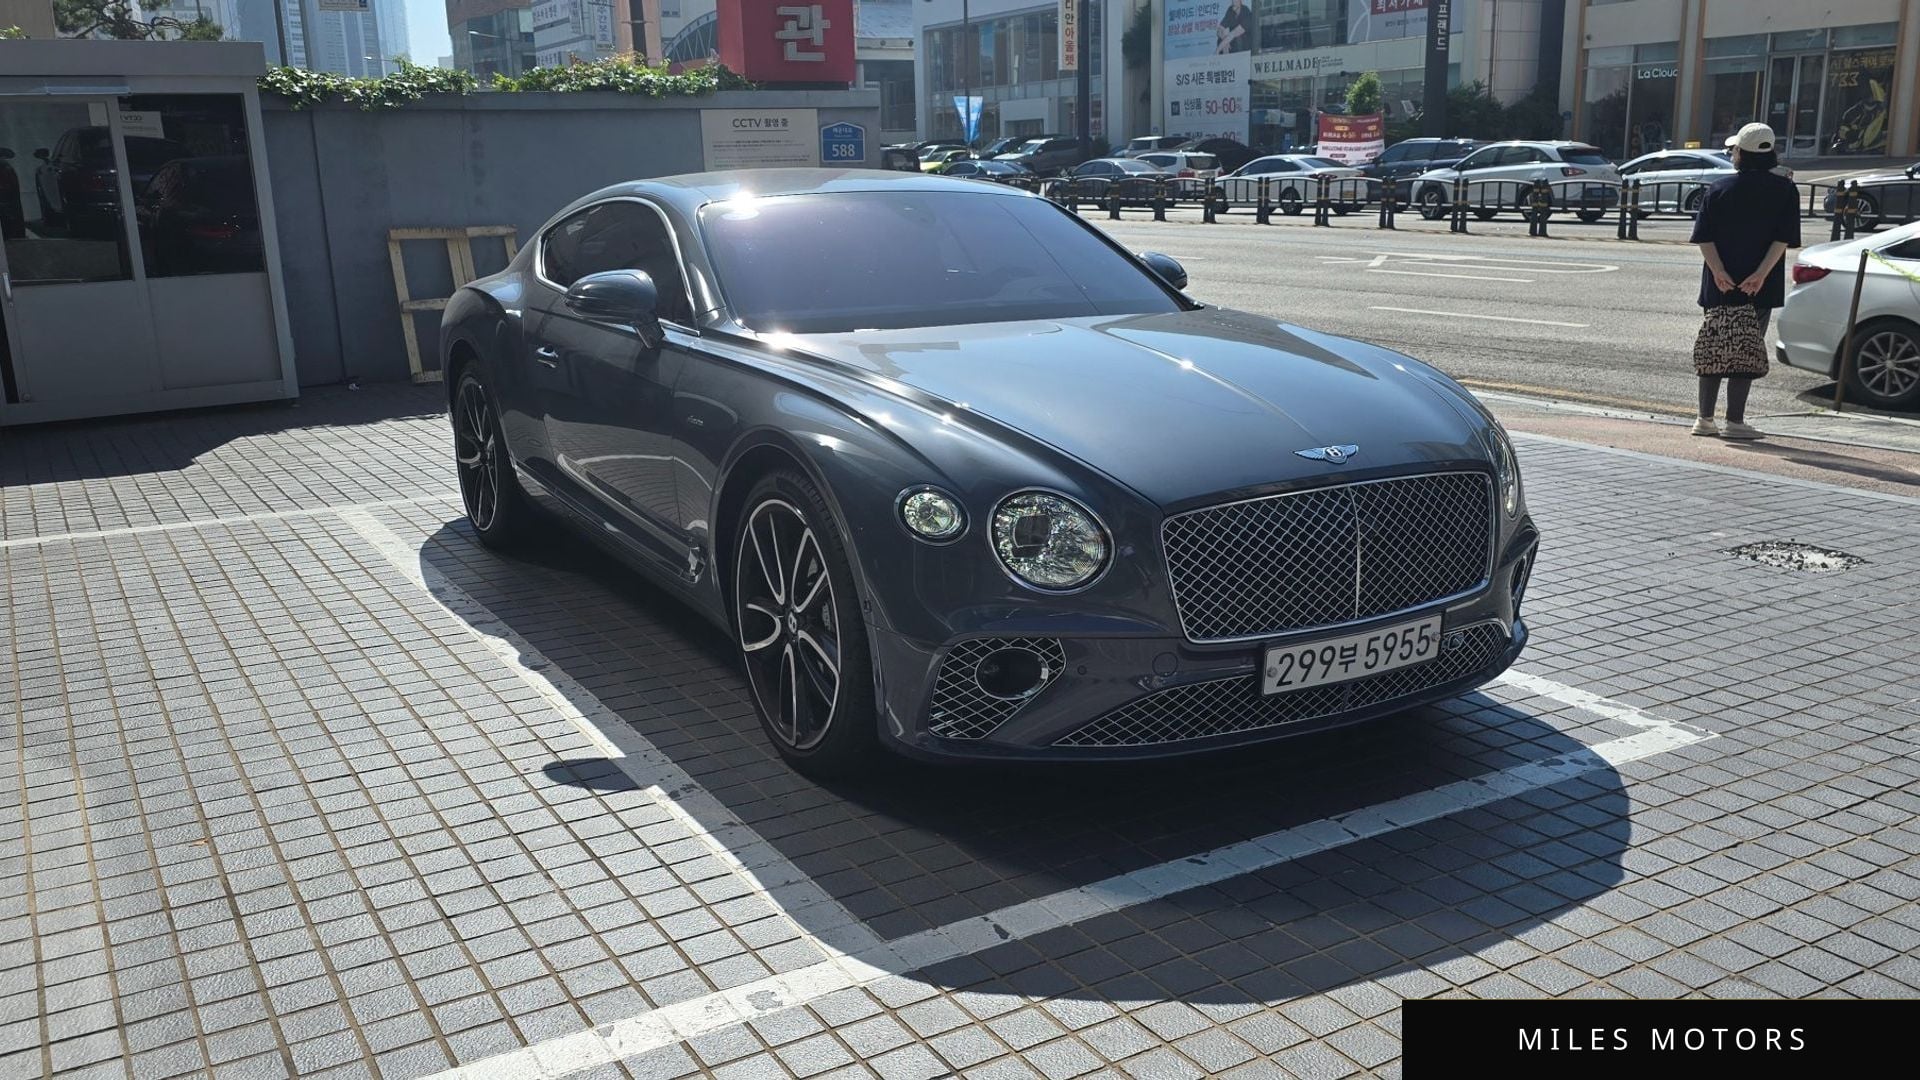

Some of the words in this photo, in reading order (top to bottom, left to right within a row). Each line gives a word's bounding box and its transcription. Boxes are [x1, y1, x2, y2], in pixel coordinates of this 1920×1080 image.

[776, 5, 831, 61] 관
[1254, 57, 1319, 73] WELLMADE
[1176, 73, 1190, 86] S/S
[1191, 72, 1205, 85] 시즌
[1206, 69, 1236, 84] 특별할인
[1638, 69, 1651, 79] La
[732, 118, 761, 128] CCTV
[832, 144, 856, 157] 588
[1276, 643, 1358, 687] 299부
[1364, 624, 1432, 670] 5955
